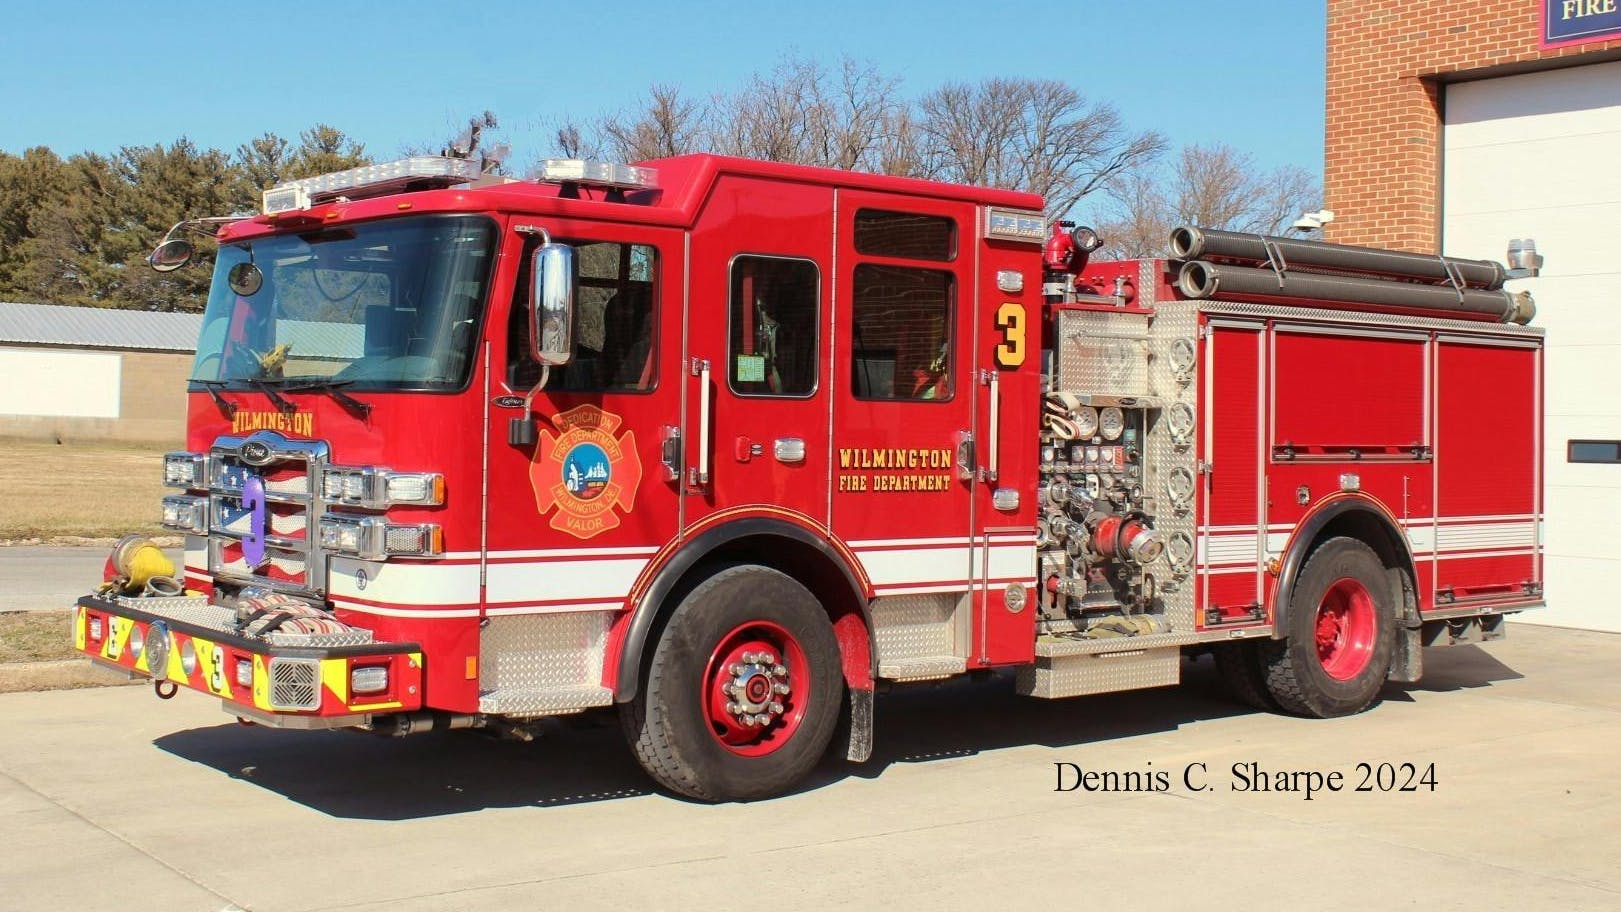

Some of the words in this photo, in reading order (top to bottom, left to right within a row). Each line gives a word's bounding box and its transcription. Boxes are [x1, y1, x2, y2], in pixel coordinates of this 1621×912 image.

[1561, 0, 1616, 20] FIRE
[994, 302, 1026, 371] 3
[563, 411, 612, 429] DEDICATION
[555, 437, 571, 458] FIRE
[571, 430, 620, 456] DEPARTMENT
[839, 448, 951, 469] WILMINGTON
[839, 475, 867, 492] FIRE
[873, 475, 951, 492] DEPARTMENT
[242, 477, 265, 568] 3
[567, 516, 603, 531] VALOR
[211, 646, 224, 692] 3
